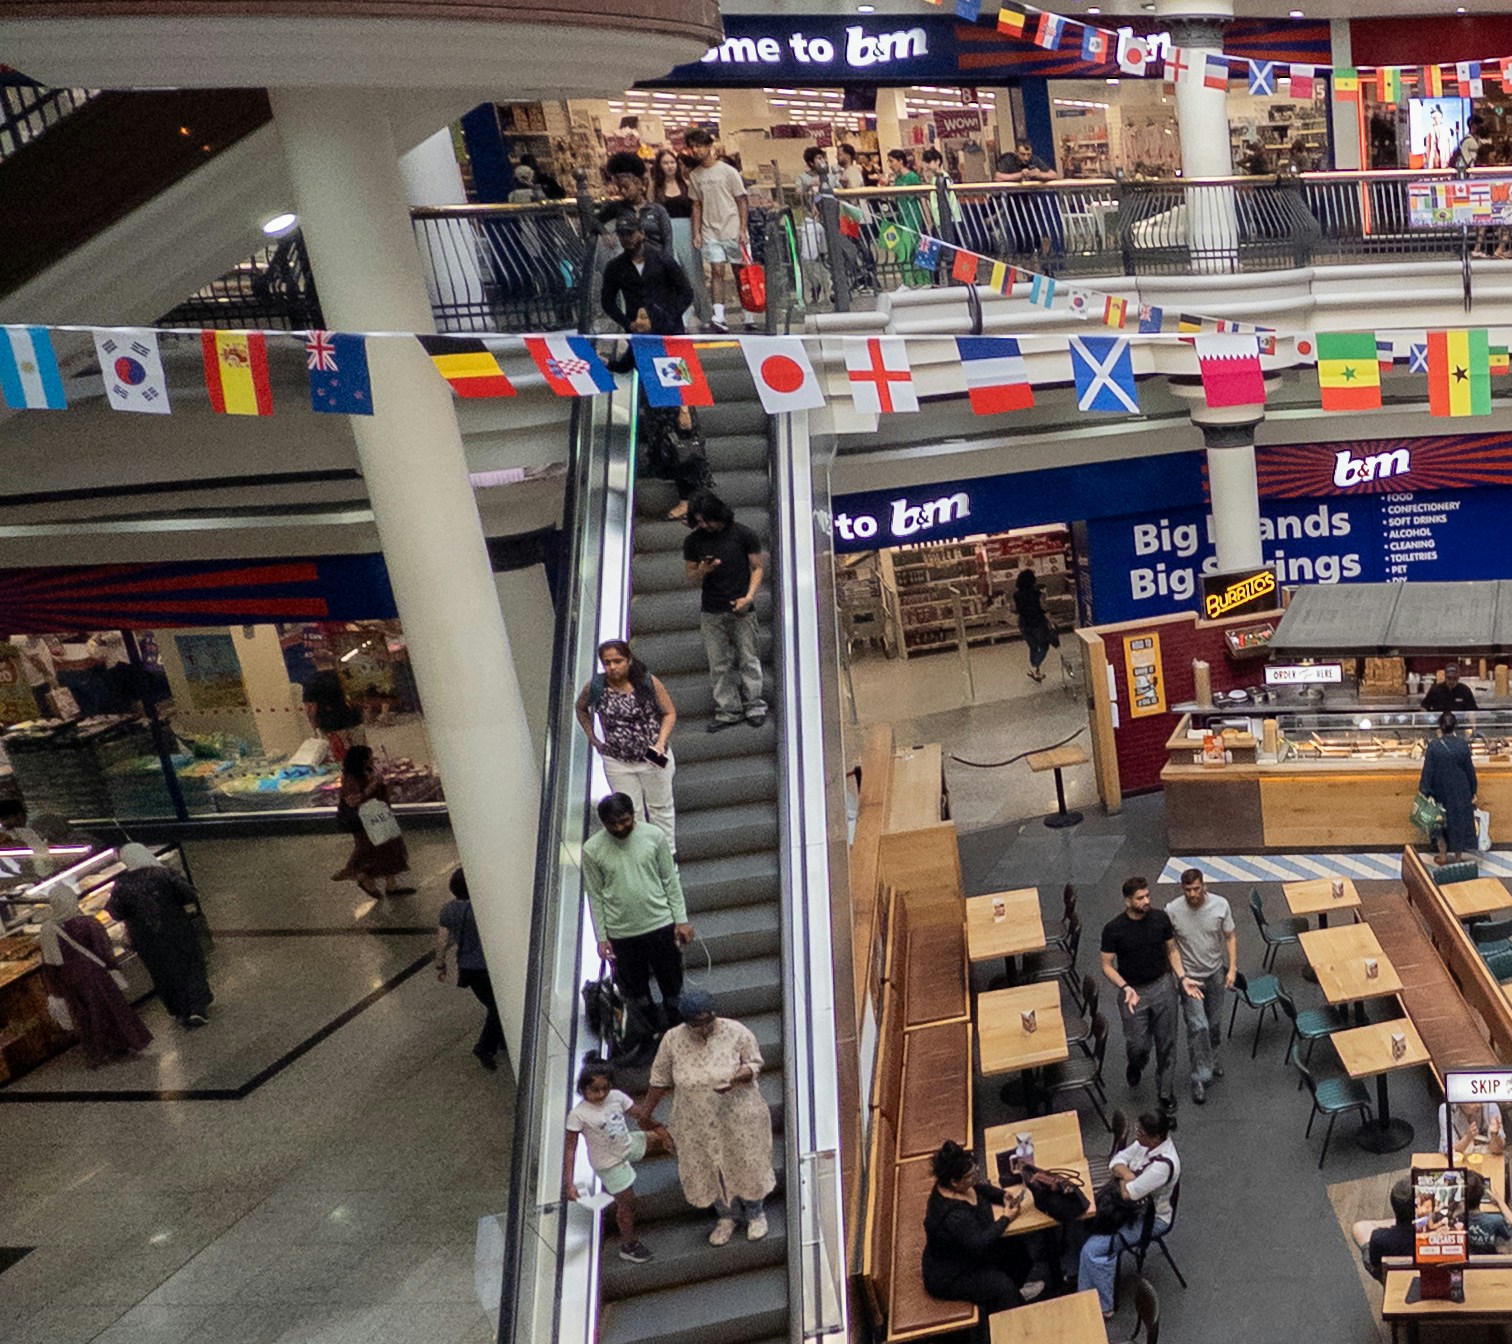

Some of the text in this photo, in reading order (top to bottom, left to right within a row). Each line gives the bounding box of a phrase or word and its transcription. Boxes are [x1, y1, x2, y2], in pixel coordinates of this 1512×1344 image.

[789, 33, 834, 62] to
[846, 26, 929, 67] b&m
[1333, 447, 1410, 489] b&m
[1387, 493, 1413, 502] FOOD
[1388, 501, 1461, 514] CONFECTIONERY
[835, 513, 878, 541] to
[890, 492, 971, 537] b&m
[1388, 514, 1447, 527] SOFT DRINKS
[1132, 518, 1199, 556] Big
[1389, 528, 1432, 539] ALCOHOL
[1390, 539, 1435, 551] CLEANING
[1390, 551, 1438, 562] TOILETRIES
[1391, 565, 1407, 574] PET
[1130, 563, 1196, 601] Big
[1206, 572, 1275, 618] BURRITOS
[1316, 668, 1333, 679] HERE
[1471, 1079, 1500, 1094] SKIP
